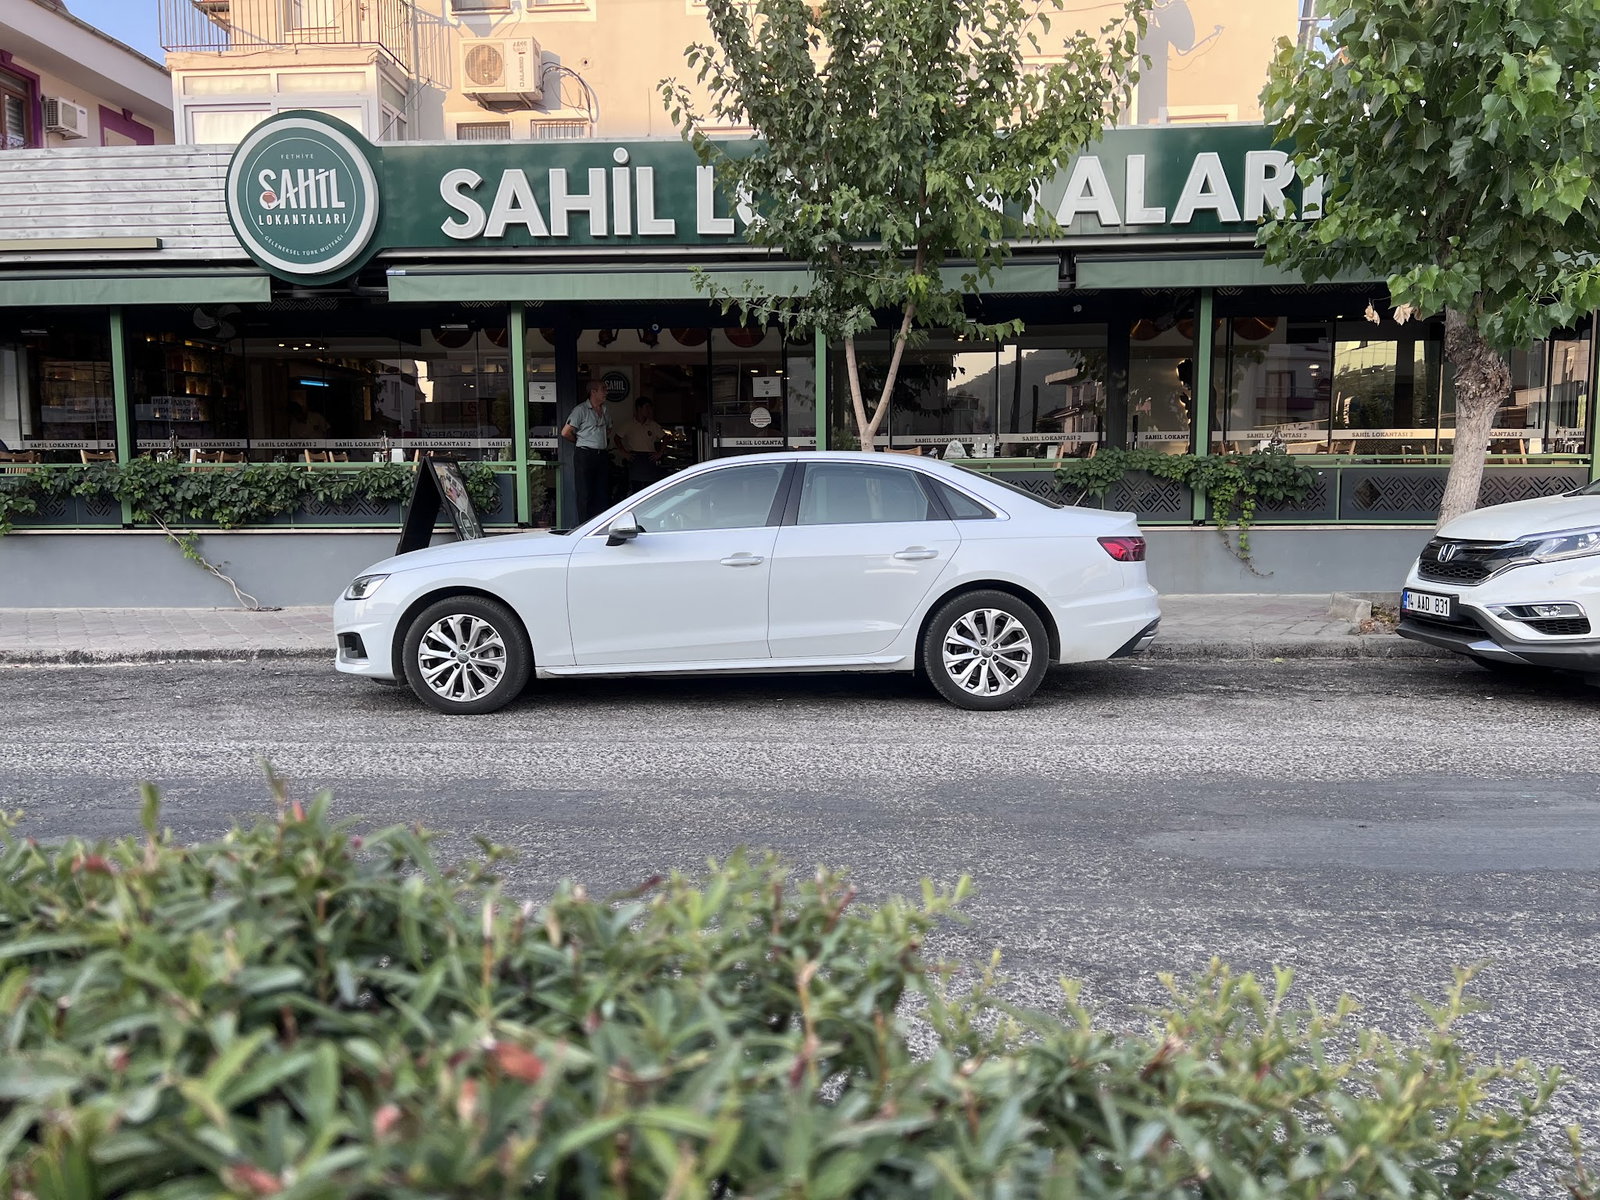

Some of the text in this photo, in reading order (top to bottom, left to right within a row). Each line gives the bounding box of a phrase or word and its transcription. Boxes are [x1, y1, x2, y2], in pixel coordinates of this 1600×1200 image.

[258, 168, 346, 210] SAHİL
[440, 147, 1325, 240] SAHİL LALARI
[258, 213, 347, 226] LOKANTALARI
[264, 233, 344, 256] GELENEKSEL TÜRK MUTFAĞI
[1417, 595, 1430, 611] AAD
[1434, 598, 1448, 615] 831
